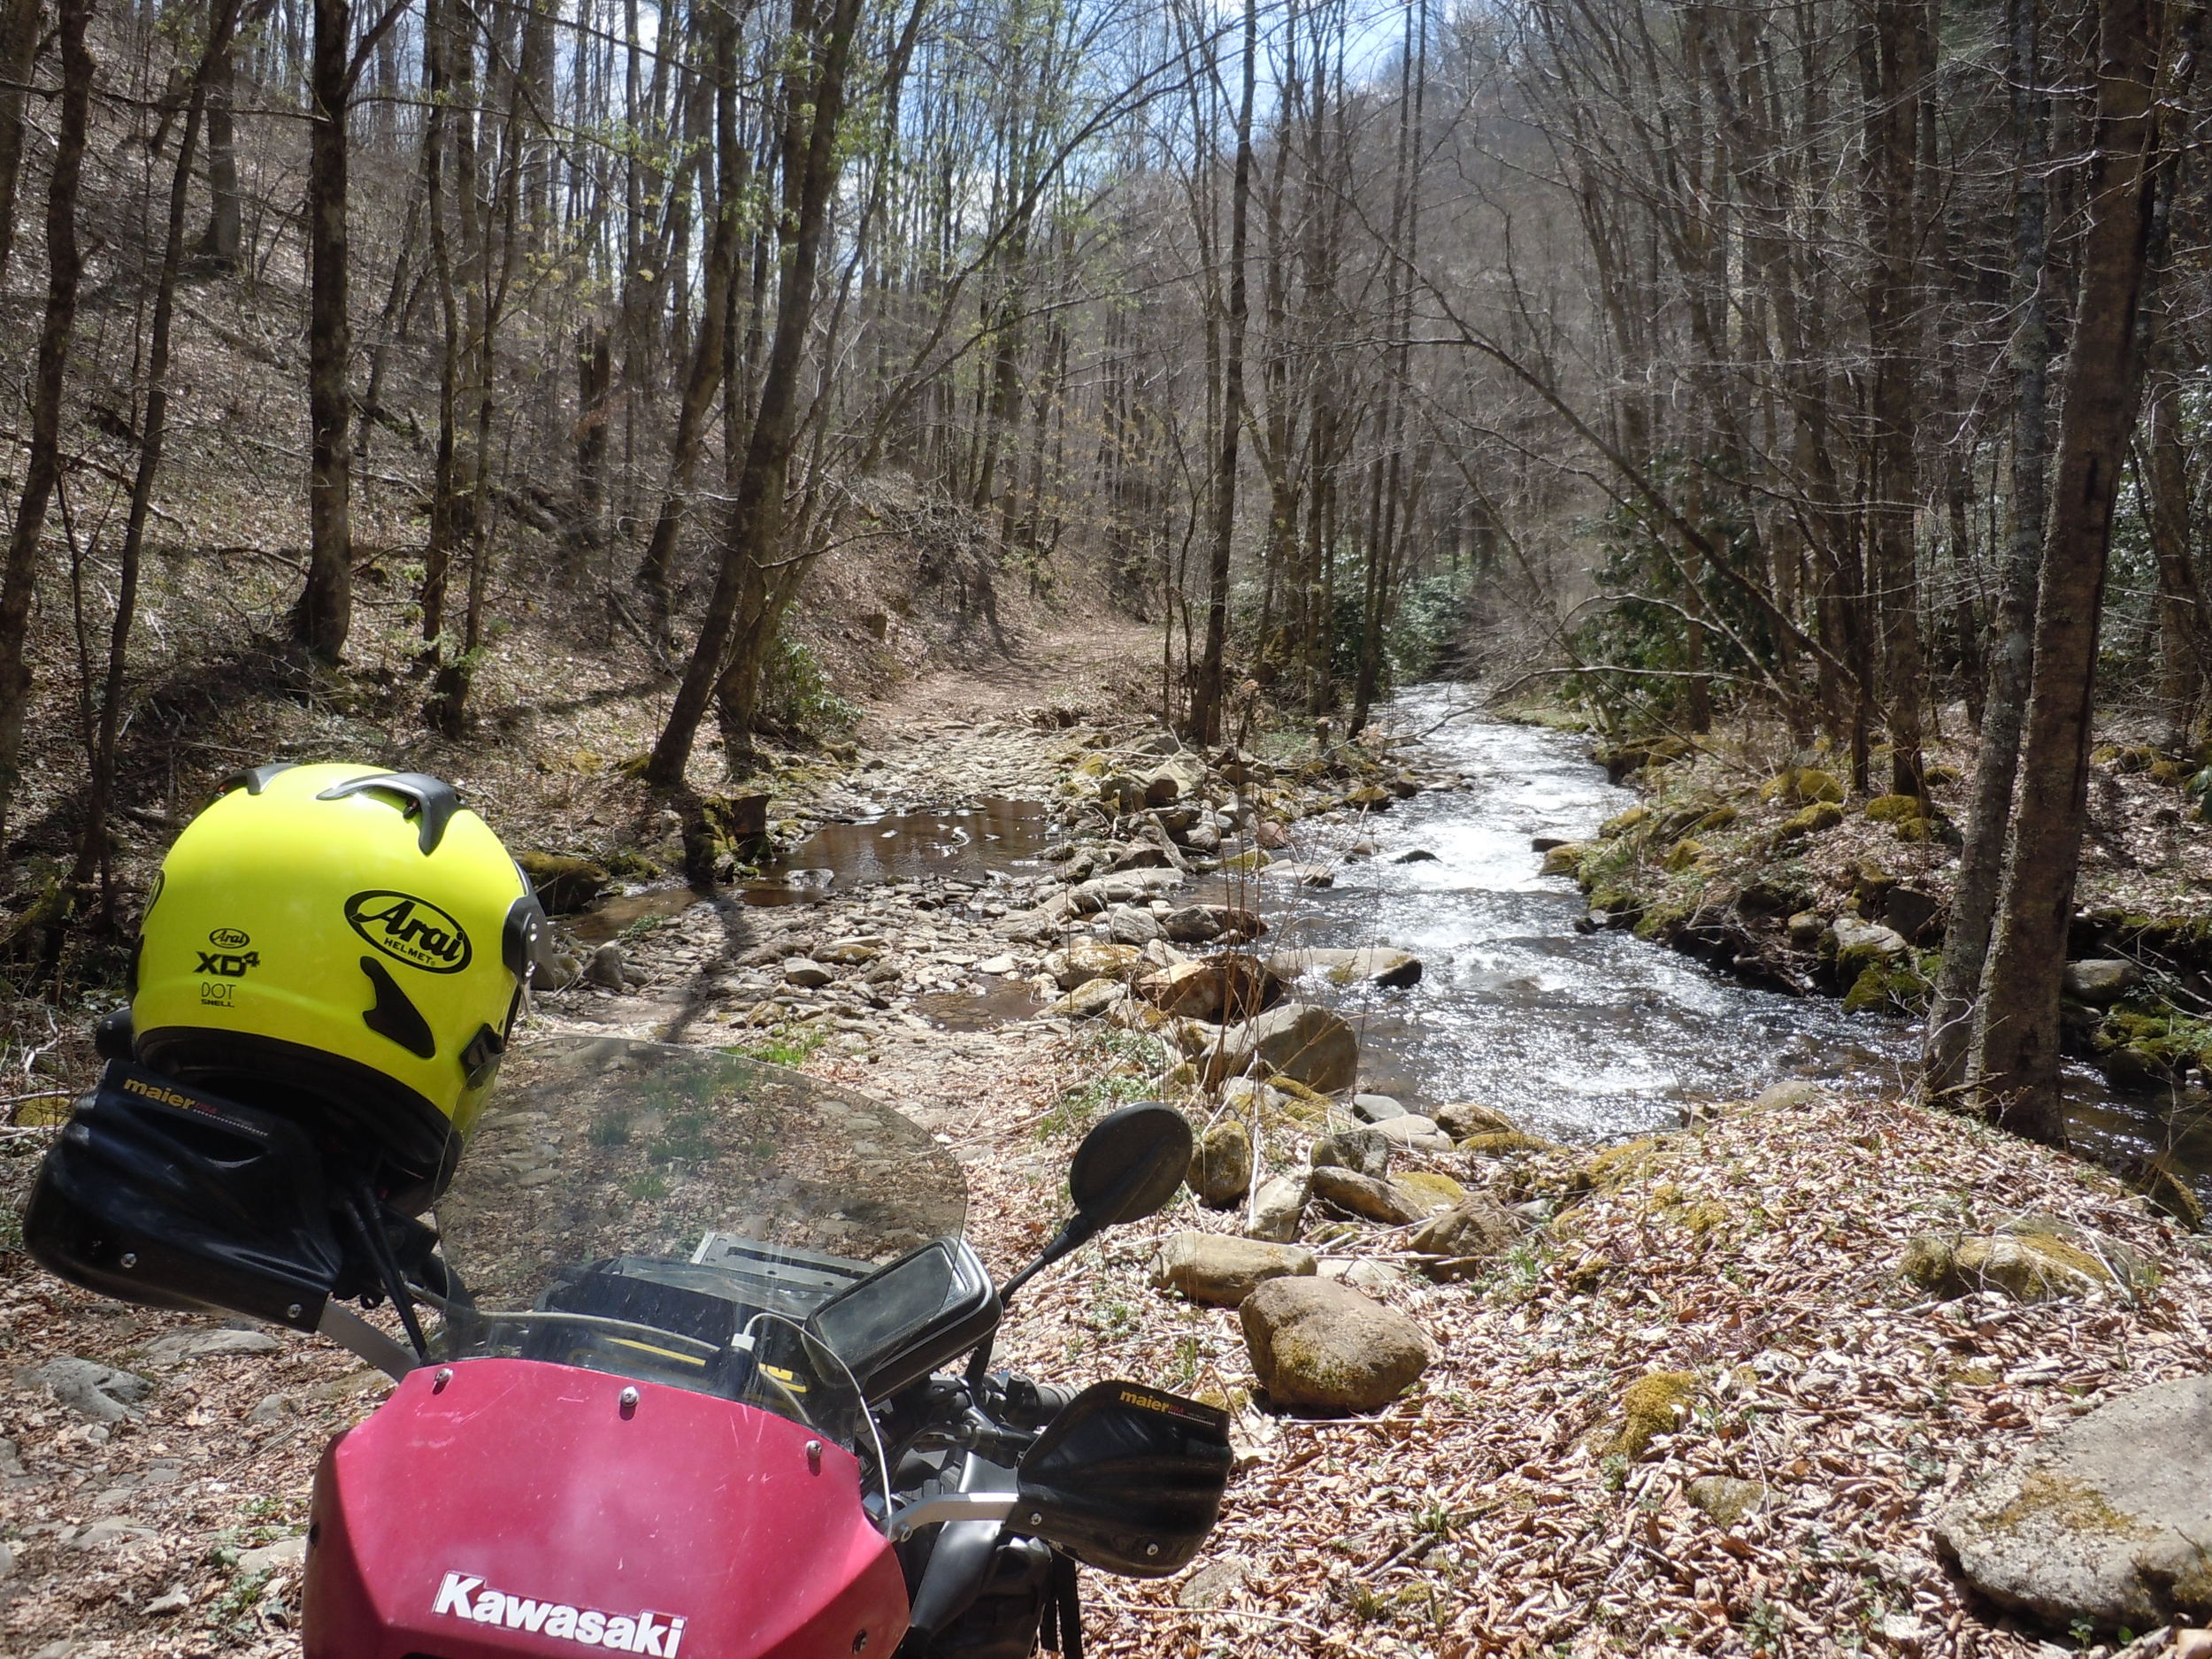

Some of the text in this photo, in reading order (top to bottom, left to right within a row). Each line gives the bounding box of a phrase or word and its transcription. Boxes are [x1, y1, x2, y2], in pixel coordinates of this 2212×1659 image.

[349, 900, 464, 961] Arai
[384, 937, 433, 964] HELMET
[201, 981, 237, 1000] DOT
[123, 1077, 196, 1110] maier
[1119, 1390, 1170, 1413] maier
[434, 1572, 685, 1659] Kawasaki
